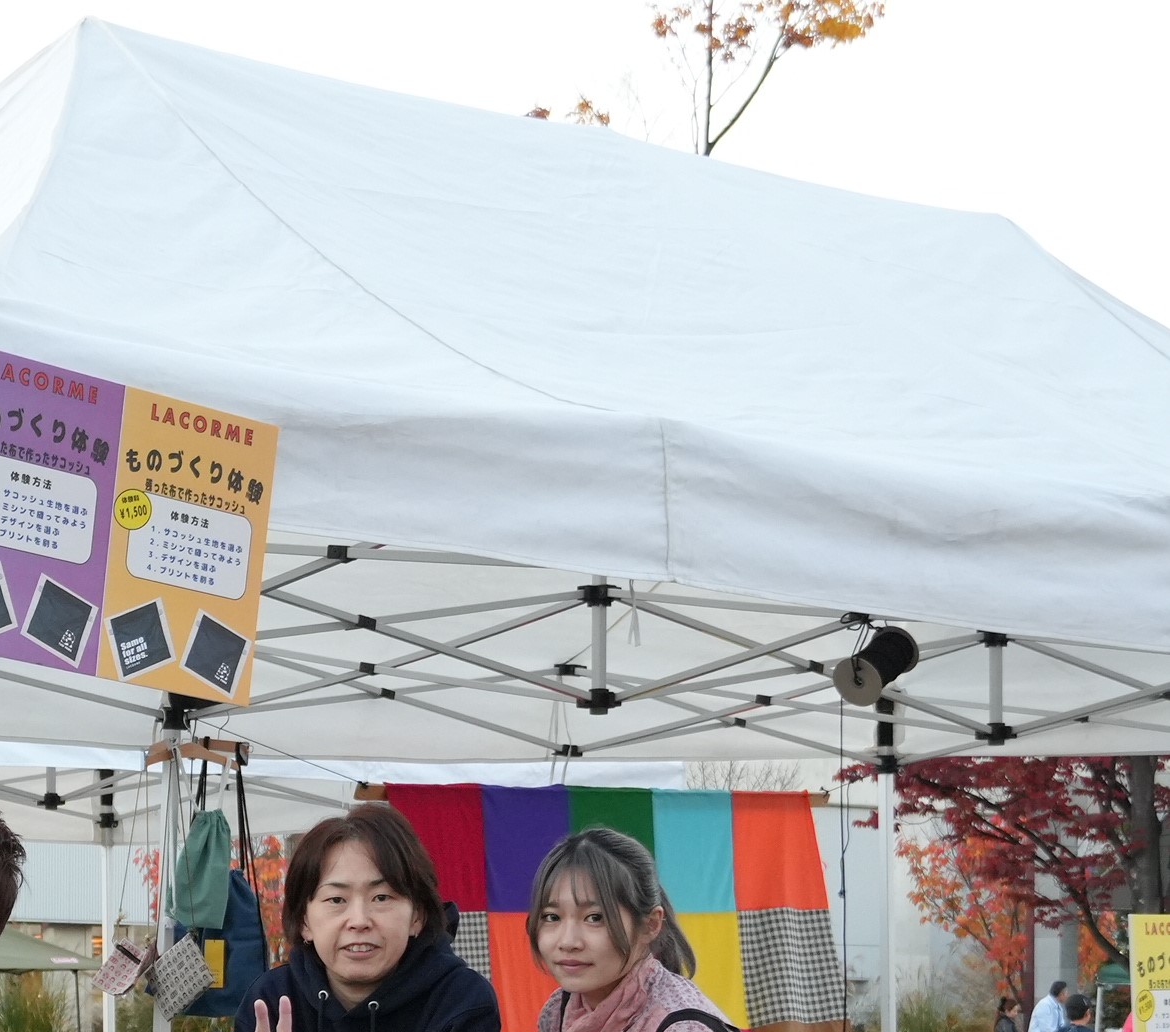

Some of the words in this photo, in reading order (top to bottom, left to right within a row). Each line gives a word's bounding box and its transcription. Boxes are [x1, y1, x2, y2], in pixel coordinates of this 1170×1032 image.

[151, 403, 254, 446] LACORME
[10, 471, 52, 490] 体験方法
[126, 449, 264, 505] ものづくり体験
[120, 505, 147, 519] ¥1,500
[170, 511, 209, 529] 体験方法
[120, 636, 145, 651] Same
[122, 648, 135, 659] for
[136, 642, 148, 653] all
[124, 652, 149, 666] sizes.
[1137, 952, 1170, 978] ものづ
